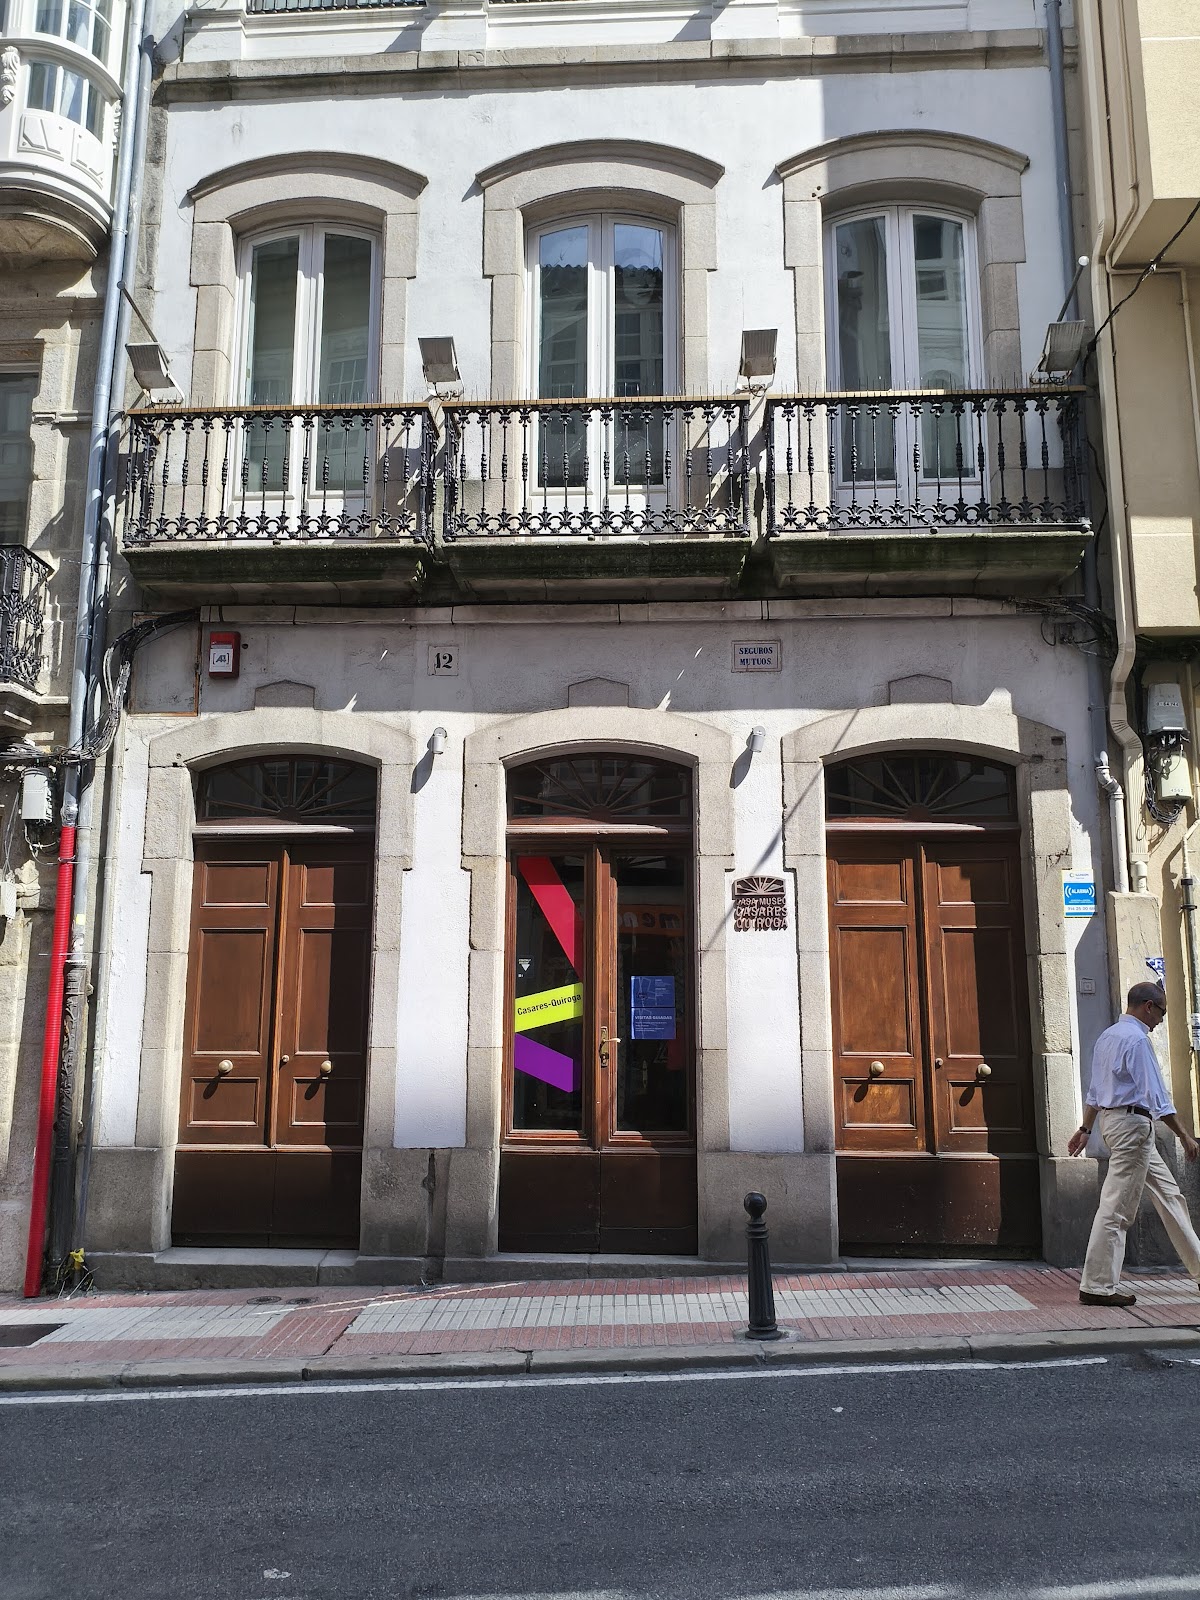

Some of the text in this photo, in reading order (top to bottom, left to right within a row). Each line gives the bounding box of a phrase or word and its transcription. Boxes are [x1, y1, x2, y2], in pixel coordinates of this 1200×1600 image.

[739, 646, 773, 655] SEGUROS
[435, 652, 453, 669] 12
[740, 657, 772, 666] MUTUOS
[736, 897, 787, 906] CASA MUSEO
[736, 906, 788, 917] CASARES
[736, 917, 788, 929] QUIROGA
[517, 994, 582, 1016] Casares-Quiroga
